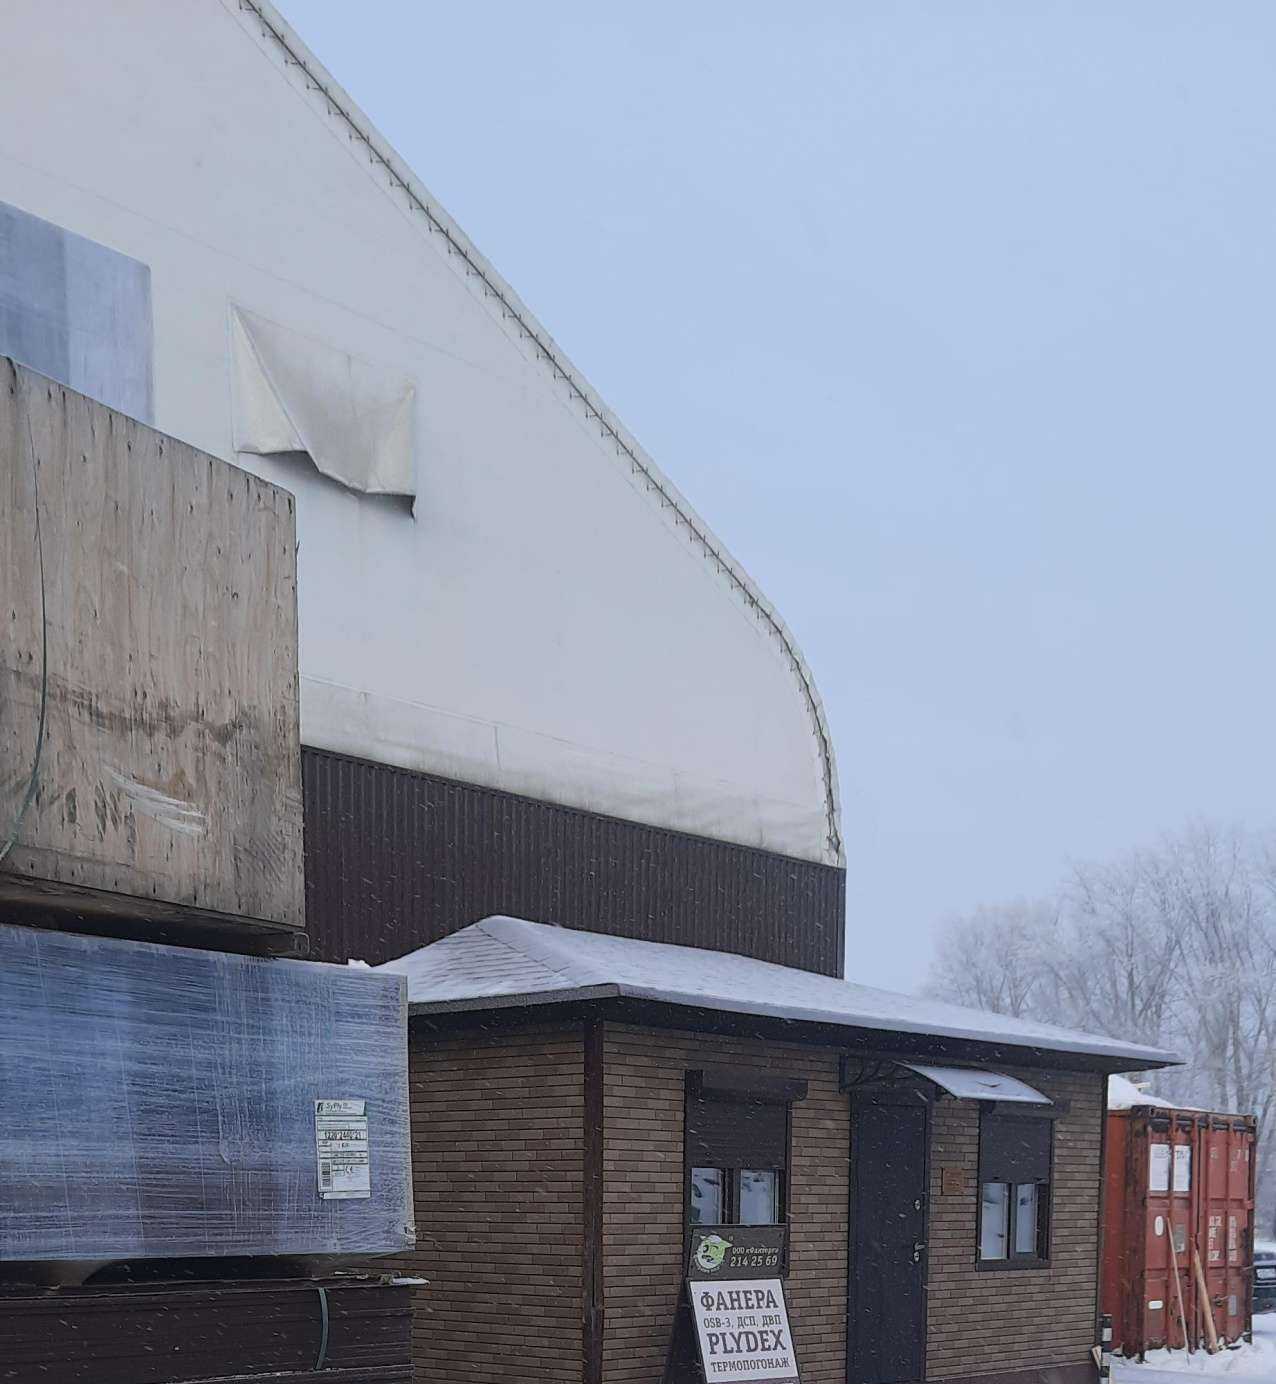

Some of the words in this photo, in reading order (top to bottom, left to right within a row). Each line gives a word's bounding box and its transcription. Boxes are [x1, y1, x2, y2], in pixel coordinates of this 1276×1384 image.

[732, 1246, 745, 1254] ООО
[730, 1256, 749, 1267] 214
[751, 1256, 763, 1267] 25
[765, 1255, 778, 1266] 69
[700, 1289, 779, 1311] ФАНЕРА
[704, 1317, 734, 1329] OSB-3,
[737, 1315, 759, 1329] ДСП,
[761, 1314, 782, 1328] ДВП
[706, 1329, 787, 1355] PLYDEX
[711, 1357, 790, 1373] ТЕРМОПОГОНАЖ
